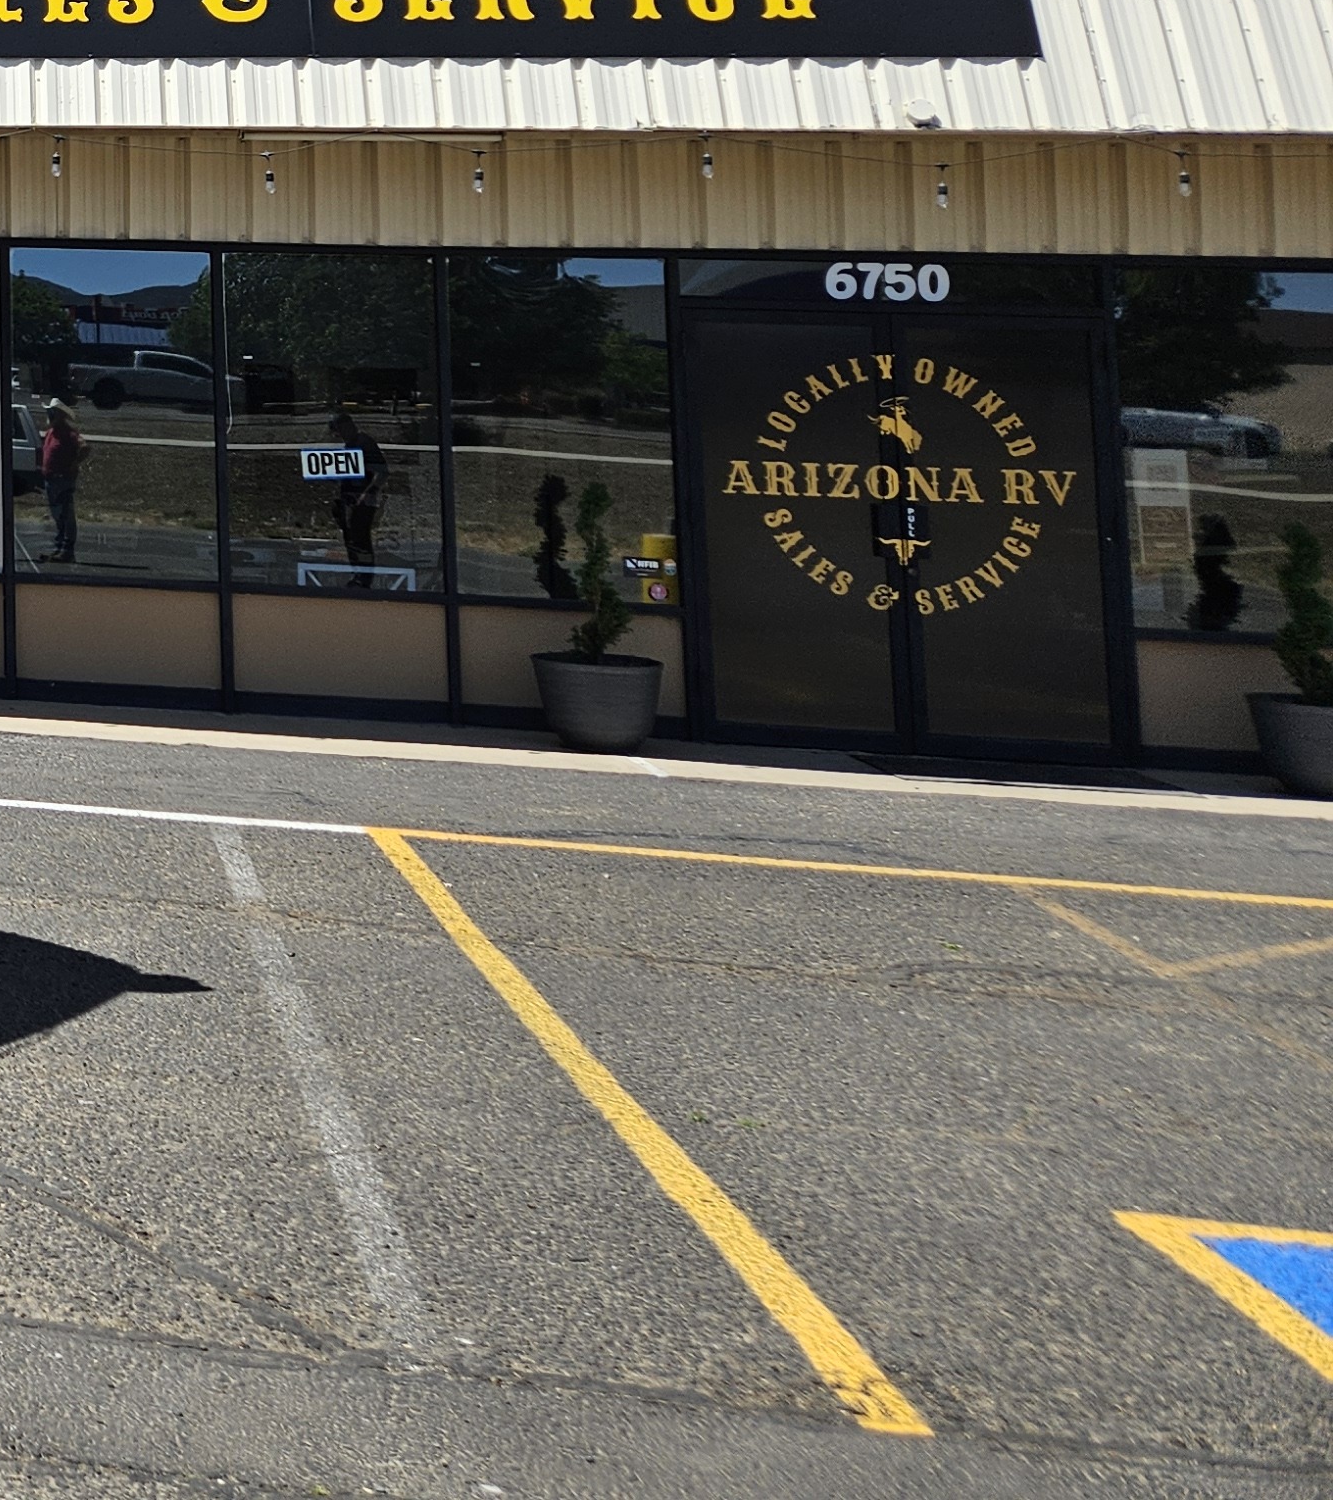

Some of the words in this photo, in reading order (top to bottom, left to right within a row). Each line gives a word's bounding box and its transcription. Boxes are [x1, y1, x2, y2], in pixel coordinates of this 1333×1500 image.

[824, 262, 950, 302] 6750
[757, 354, 896, 452] LOCALLY
[914, 357, 1037, 457] OWNED
[307, 452, 360, 475] OPEN
[722, 460, 985, 504] ARIZONA
[1002, 468, 1077, 506] RV
[907, 507, 915, 538] PULL
[763, 508, 854, 596] SALES
[866, 584, 900, 611] &
[915, 516, 1041, 615] SERVICE
